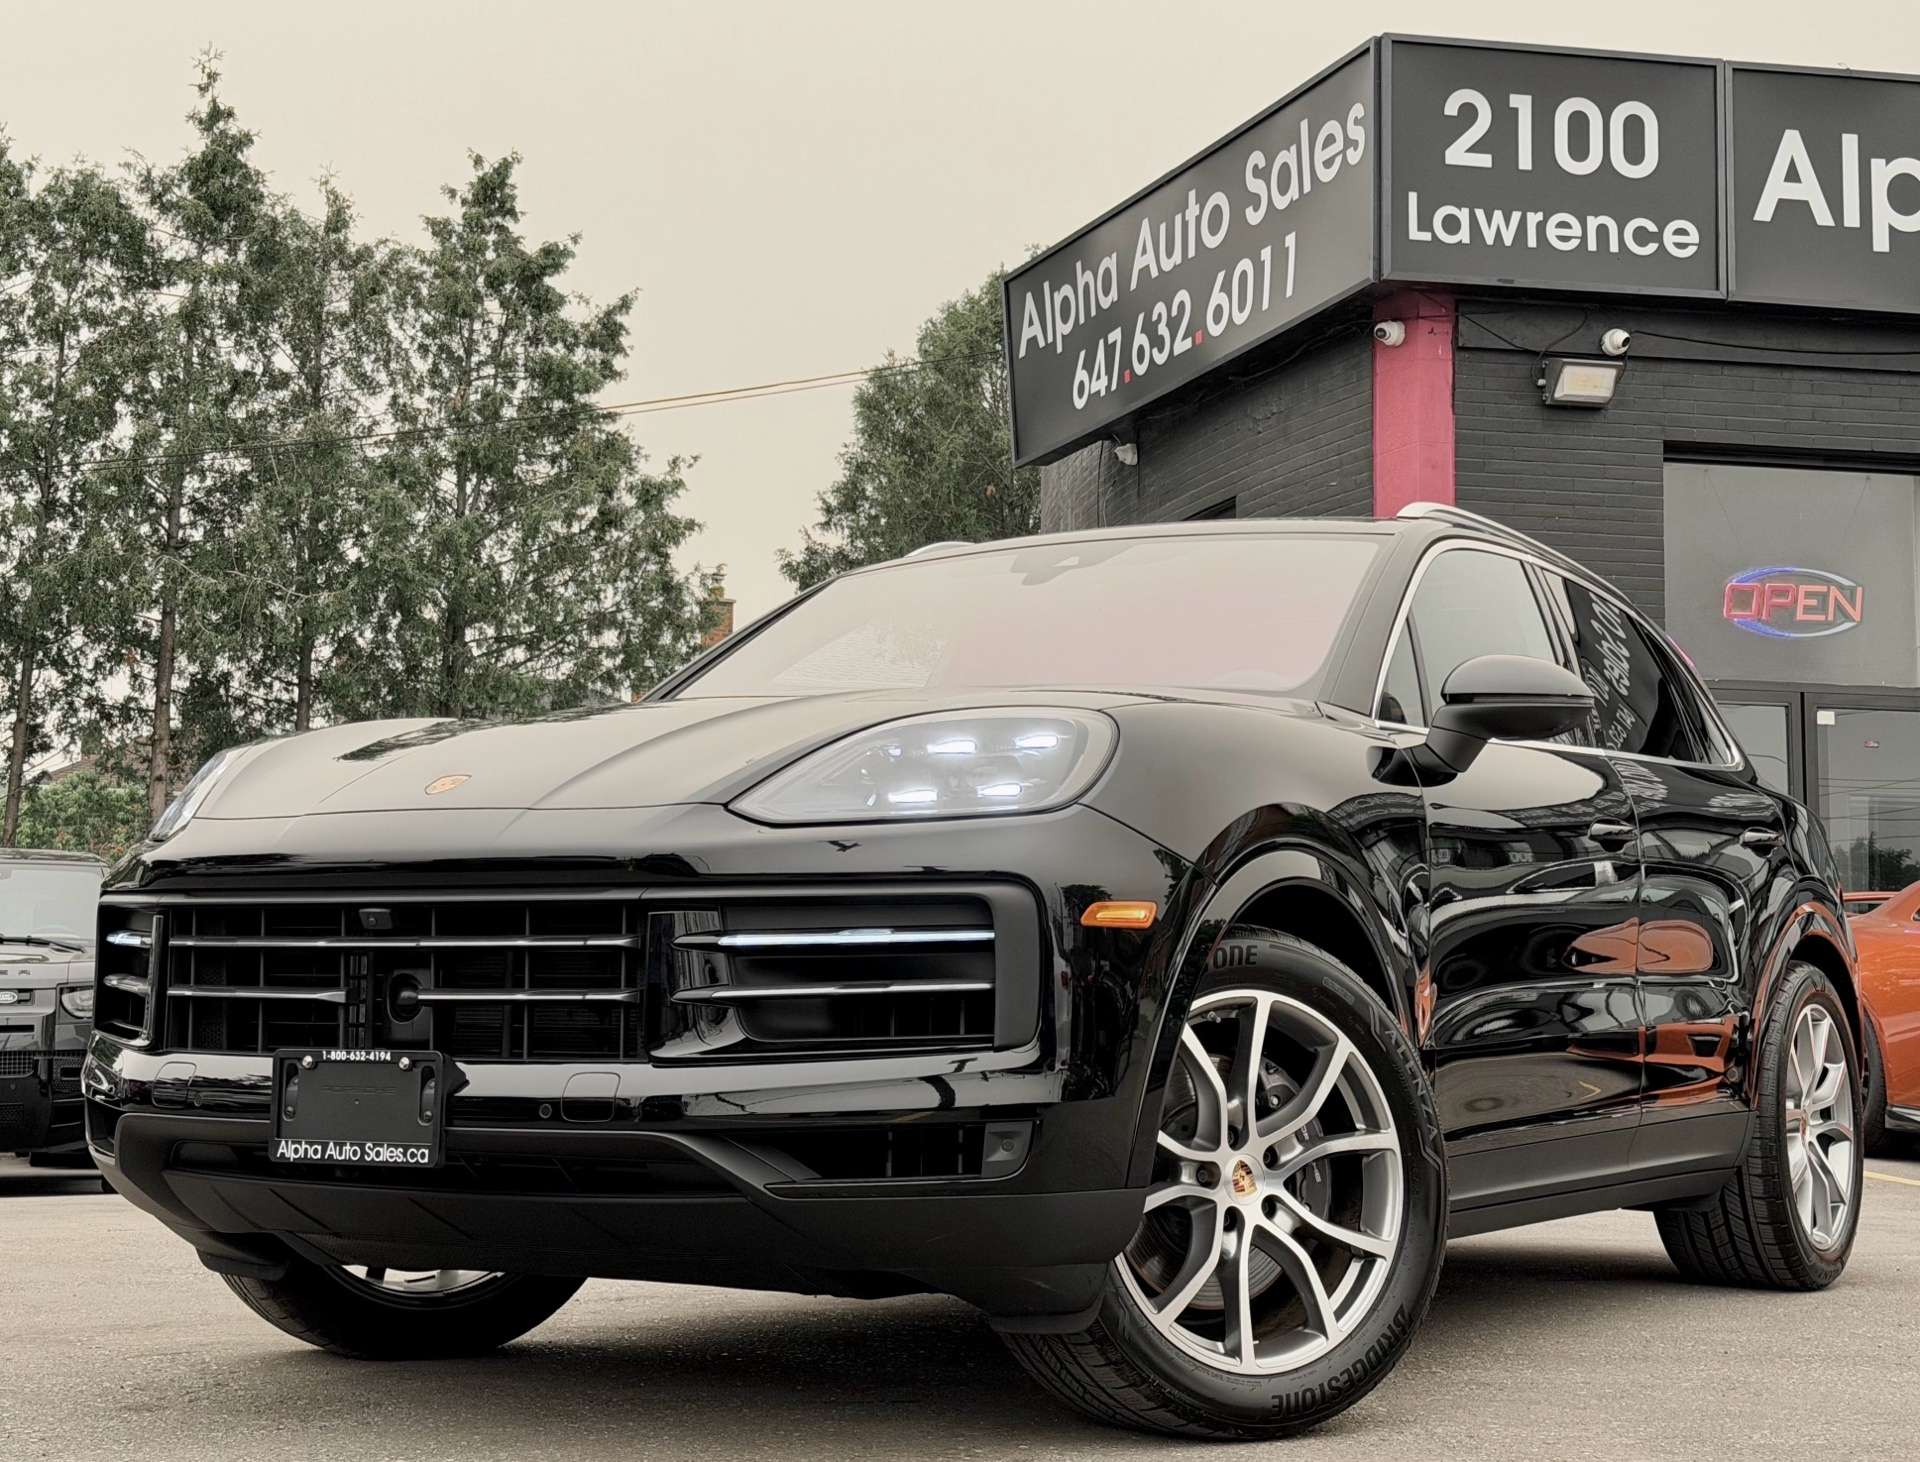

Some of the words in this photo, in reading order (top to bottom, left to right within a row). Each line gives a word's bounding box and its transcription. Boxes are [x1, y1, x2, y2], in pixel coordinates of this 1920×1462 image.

[1443, 88, 1659, 179] 2100
[1018, 251, 1118, 358] Alpha
[1130, 188, 1230, 292] Auto
[1246, 102, 1366, 226] Sales
[1408, 191, 1700, 258] Lawrence
[1753, 129, 1920, 253] Alp
[1072, 231, 1296, 410] 647.632.6011
[1724, 583, 1863, 623] OPEN
[322, 1050, 392, 1061] 1-800-632-4194
[276, 1139, 322, 1162] Alpha
[324, 1141, 361, 1161] Auto
[363, 1142, 429, 1164] Sales.ca
[1271, 1303, 1413, 1417] BRIDGESTONE
